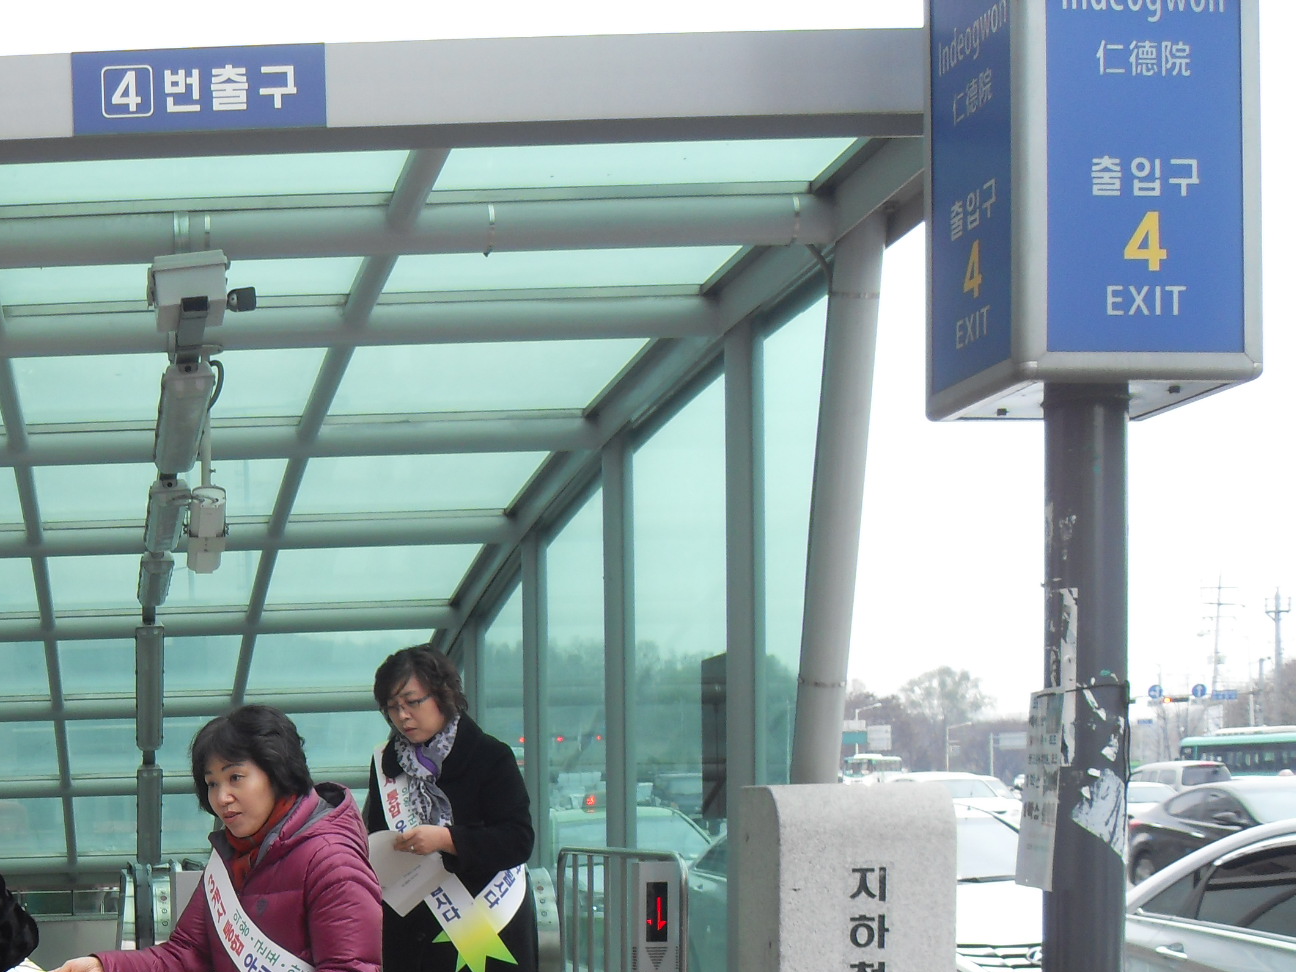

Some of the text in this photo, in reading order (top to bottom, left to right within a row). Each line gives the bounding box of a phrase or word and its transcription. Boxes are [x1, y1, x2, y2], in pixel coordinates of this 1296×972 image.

[1097, 40, 1192, 77] 仁德院
[111, 64, 298, 113] 4 번출구
[951, 67, 993, 126] 仁德院
[1090, 155, 1200, 197] 출입구
[950, 178, 997, 242] 출입구
[1124, 210, 1167, 271] 4
[963, 238, 983, 298] 4
[1106, 285, 1187, 316] EXIT
[955, 305, 991, 350] EXIT
